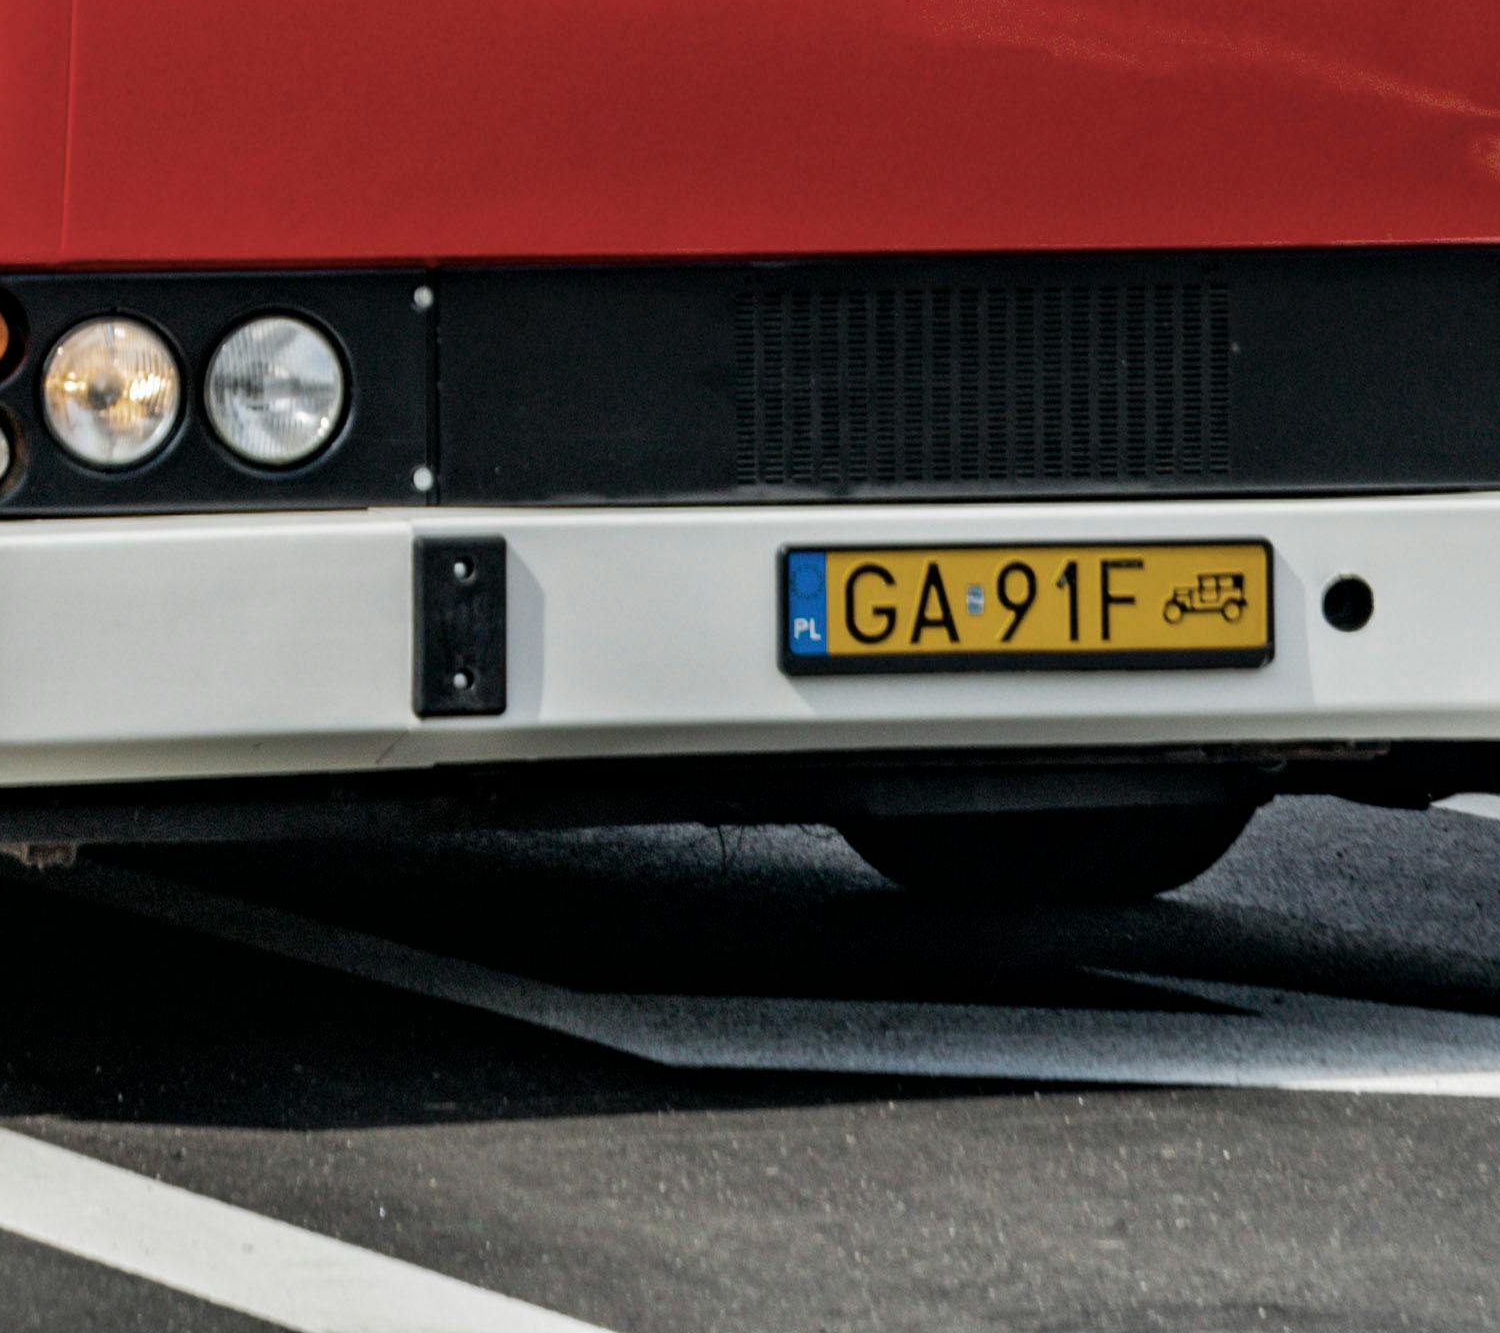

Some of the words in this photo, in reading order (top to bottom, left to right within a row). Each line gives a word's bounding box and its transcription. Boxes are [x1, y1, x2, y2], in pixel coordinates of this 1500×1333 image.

[792, 617, 823, 642] PL
[844, 559, 961, 645] GA
[995, 558, 1145, 644] 91F
